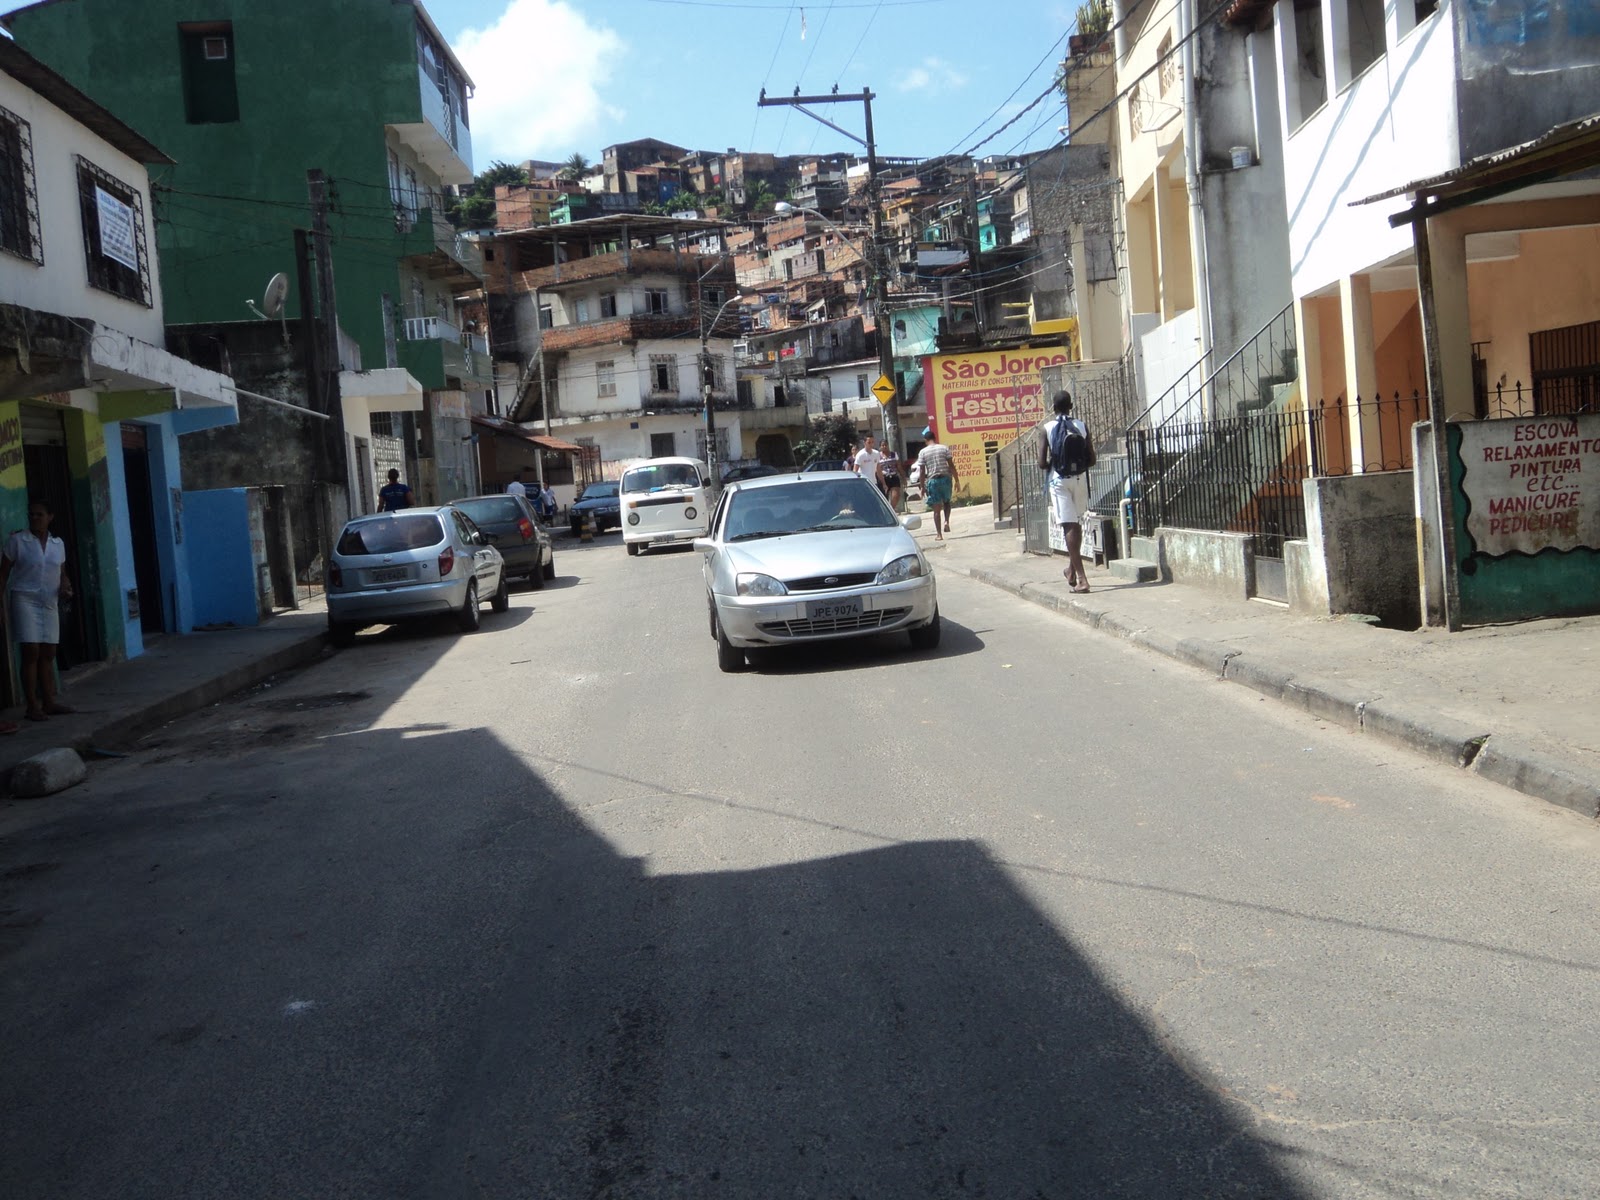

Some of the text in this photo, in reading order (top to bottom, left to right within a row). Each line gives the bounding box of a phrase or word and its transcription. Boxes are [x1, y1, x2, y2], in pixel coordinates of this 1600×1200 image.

[941, 359, 990, 380] São
[941, 379, 979, 391] MATERIAIS
[970, 391, 990, 399] TINTAS
[969, 417, 990, 426] TINTA
[1514, 422, 1579, 442] ESCOVA
[952, 449, 980, 457] RENOSO
[1483, 438, 1600, 462] RELAXAMENTO
[1510, 458, 1581, 479] PINTURA
[1489, 491, 1581, 514] MANICURE
[1489, 512, 1573, 536] PEDICURE
